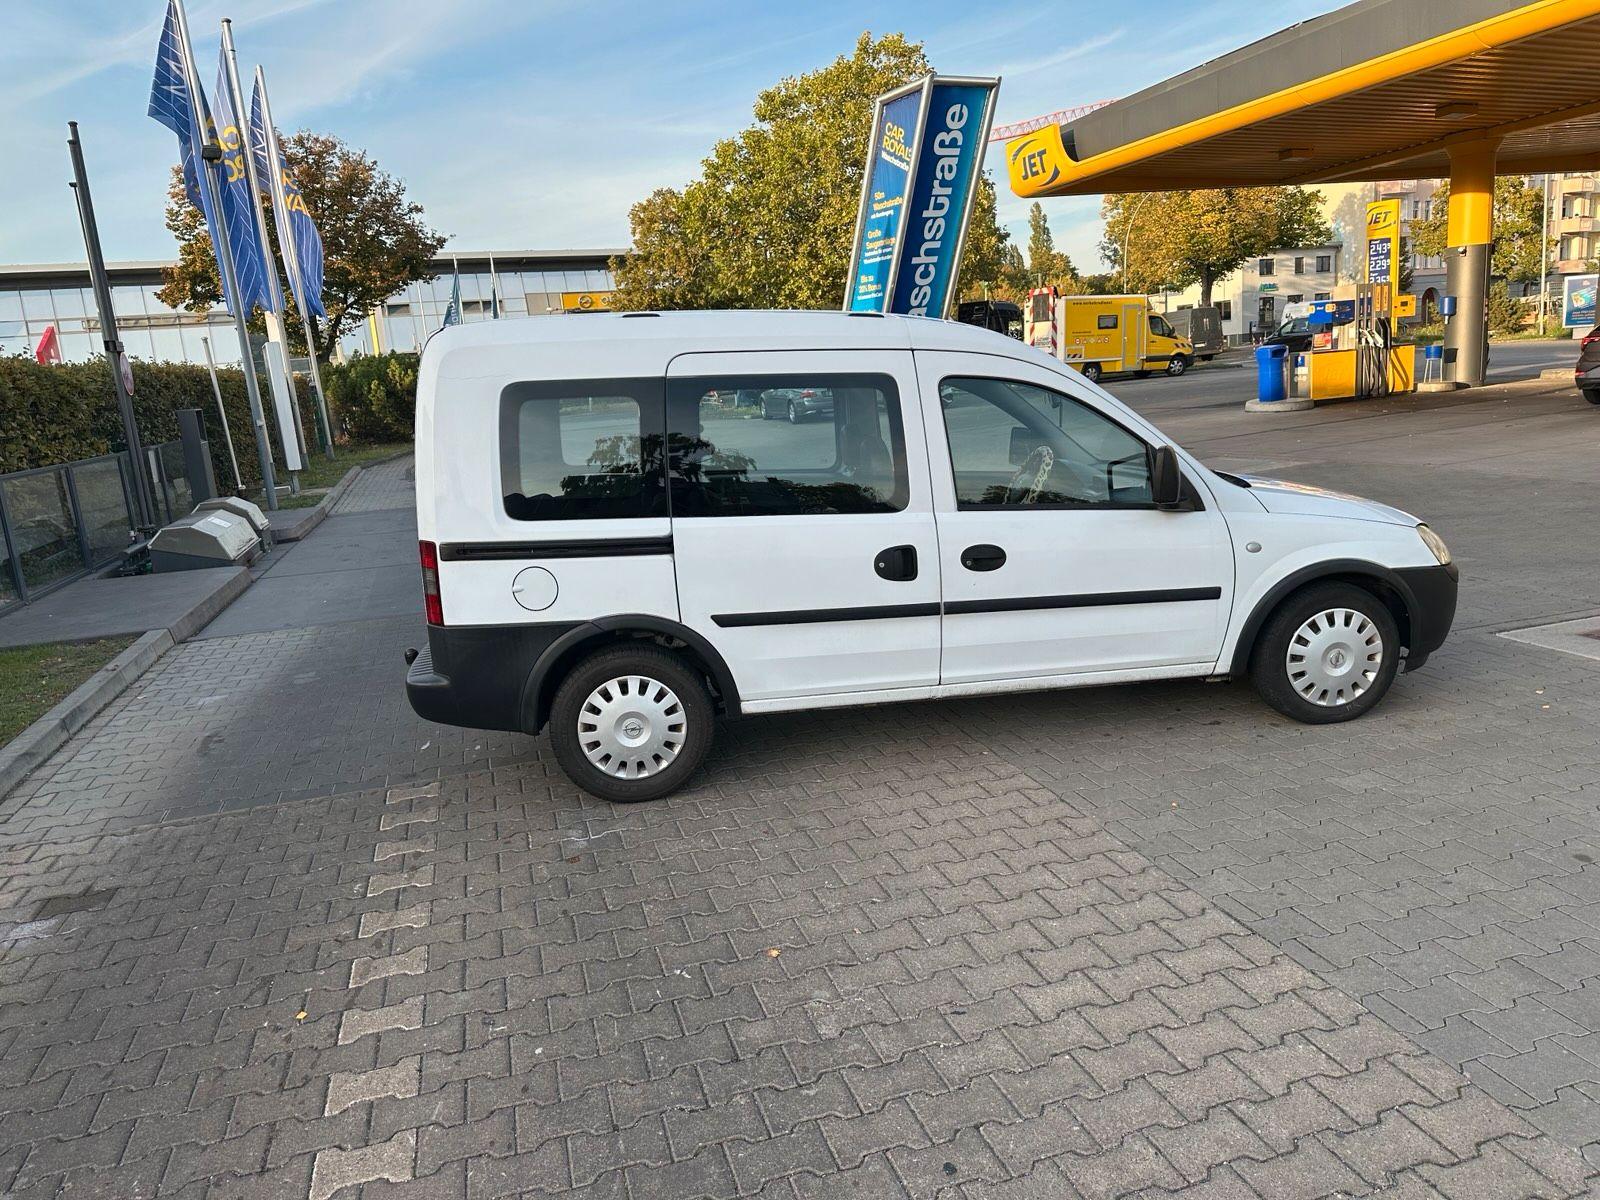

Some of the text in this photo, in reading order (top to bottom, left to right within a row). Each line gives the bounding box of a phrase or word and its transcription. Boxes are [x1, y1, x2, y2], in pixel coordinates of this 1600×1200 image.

[885, 122, 905, 143] CAR
[882, 135, 911, 161] ROYAL
[1021, 148, 1047, 181] JET
[1367, 210, 1391, 226] JET
